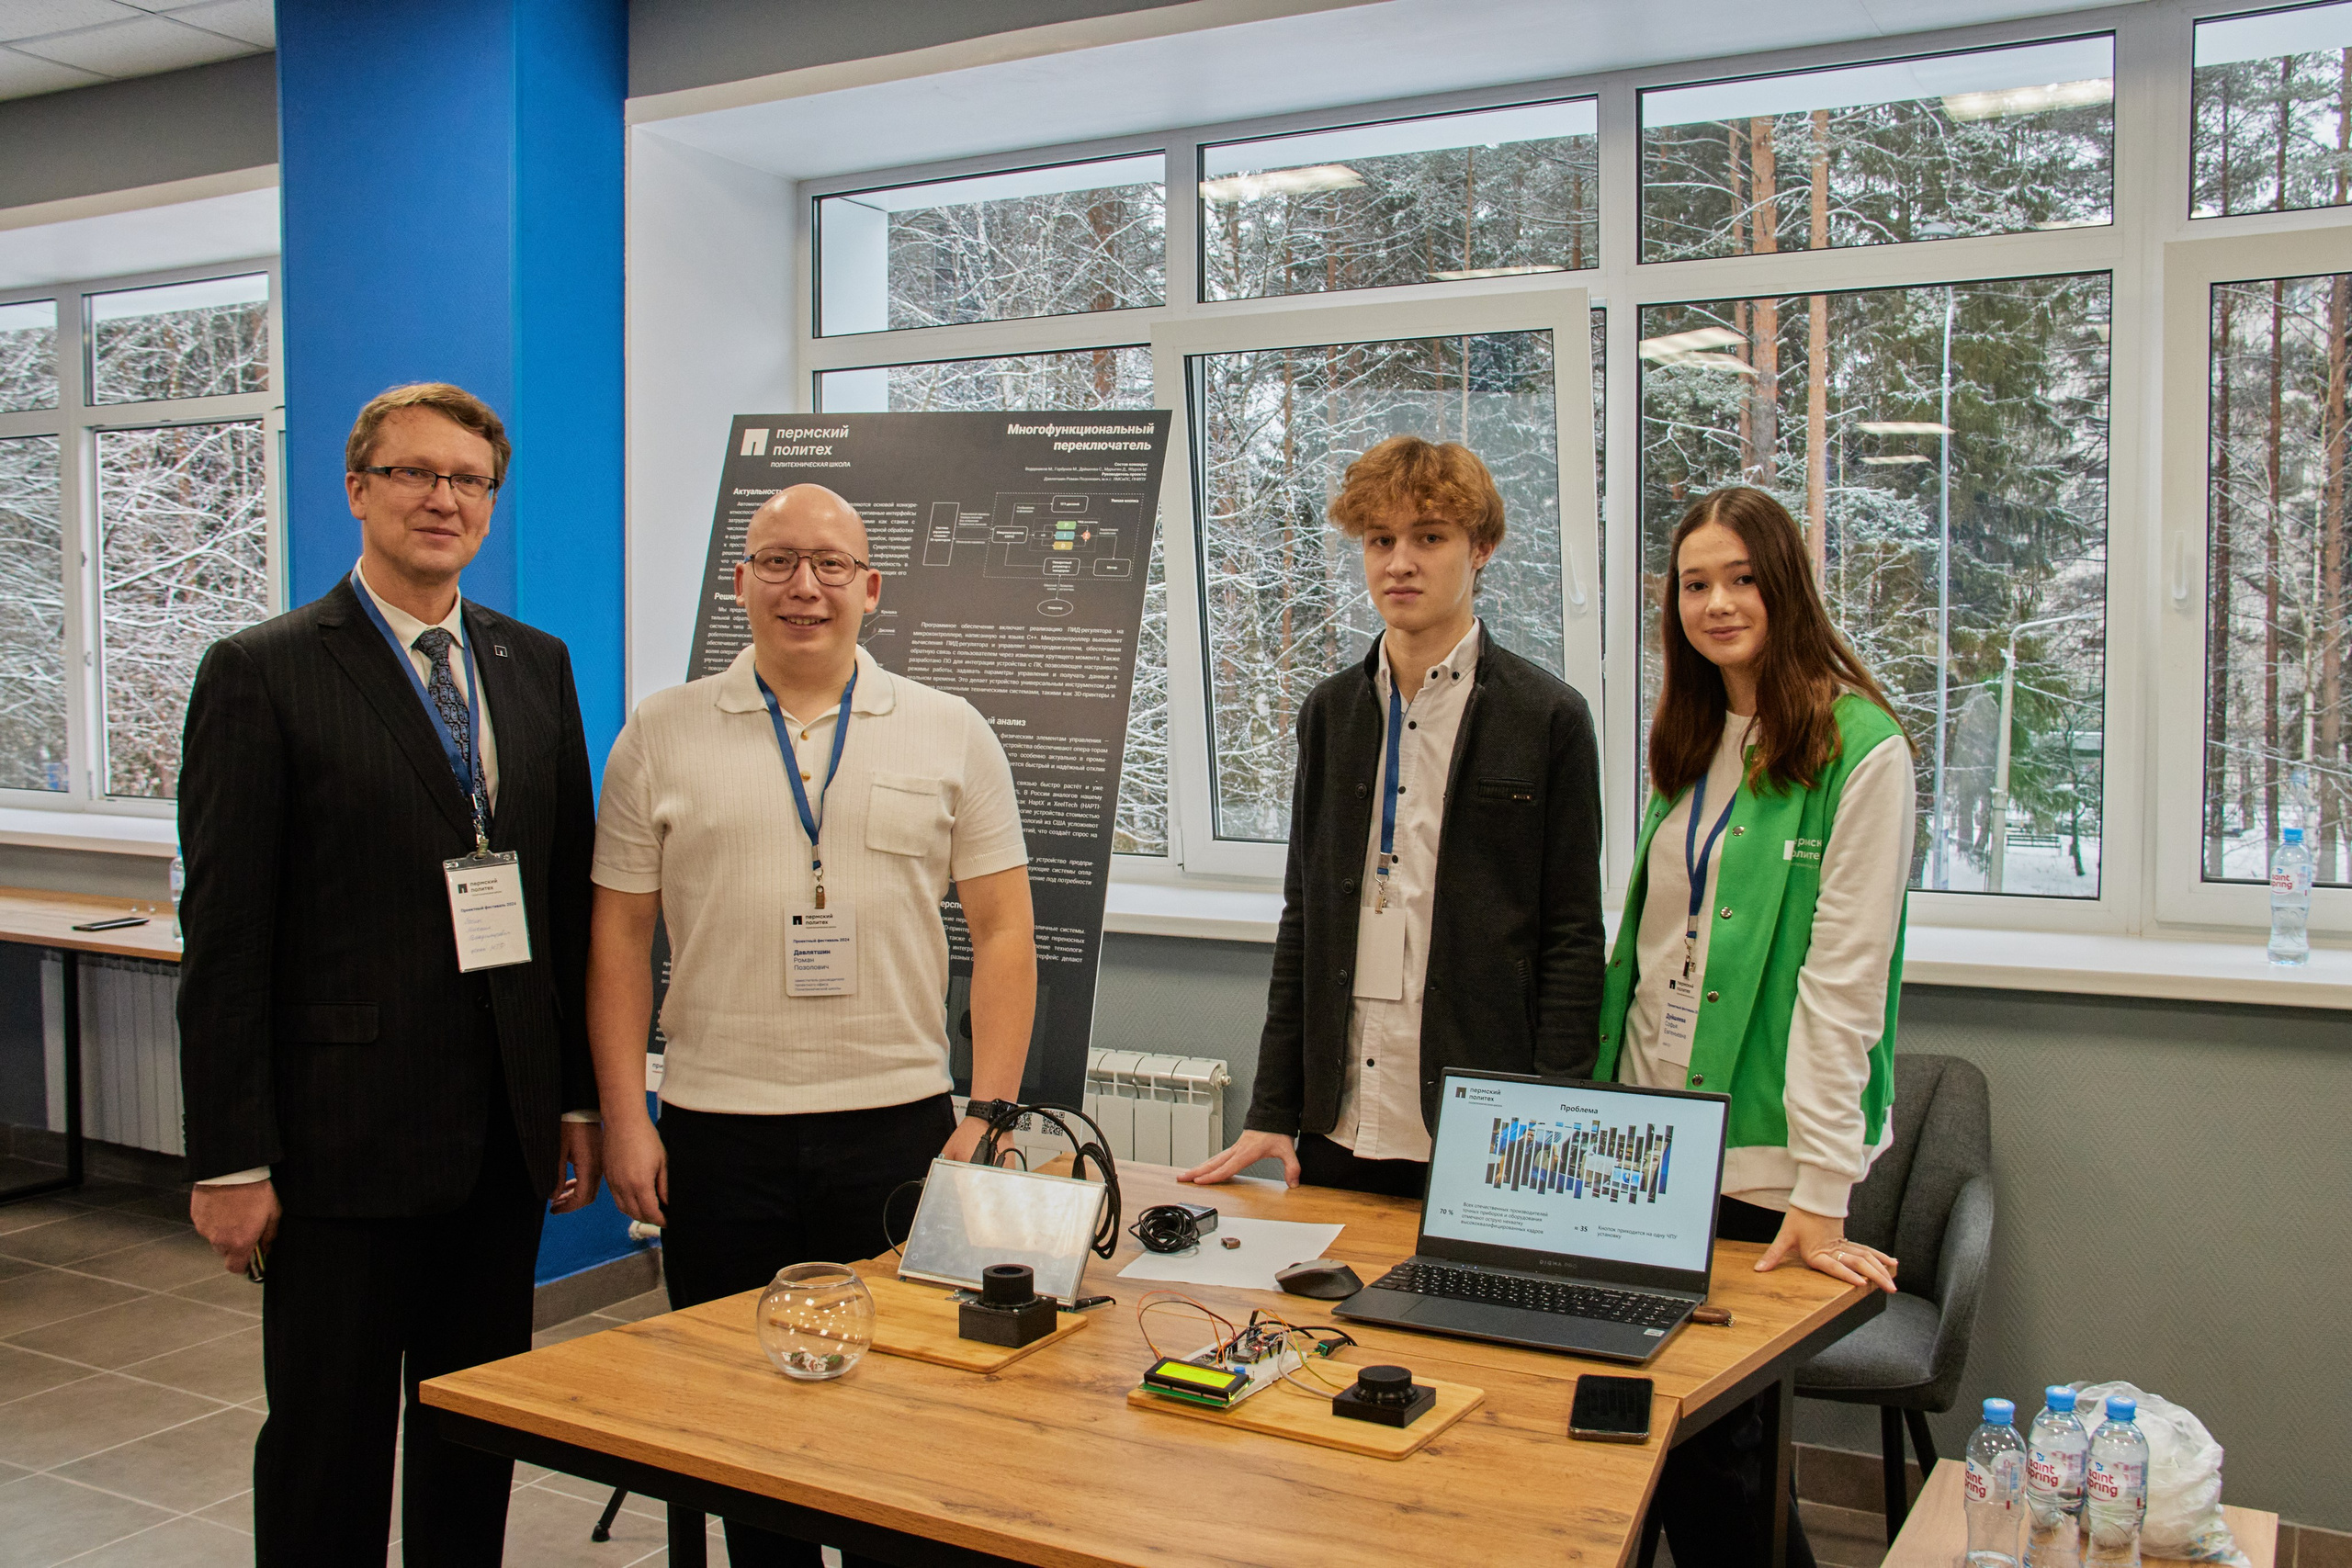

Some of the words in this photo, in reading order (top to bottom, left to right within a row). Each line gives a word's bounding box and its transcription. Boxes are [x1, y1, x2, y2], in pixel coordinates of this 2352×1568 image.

[776, 425, 850, 442] пермский
[1007, 423, 1155, 437] Многофункциональный
[773, 445, 832, 456] политех
[1053, 441, 1152, 453] переключатель
[922, 621, 957, 629] Программное
[997, 718, 1026, 727] анализ
[1025, 761, 1049, 770] быстрый
[1035, 856, 1067, 864] устройство
[2270, 880, 2293, 890] pring
[1051, 935, 1085, 943] переносных
[1061, 955, 1082, 964] делают
[1470, 1087, 1501, 1096] пермский
[1469, 1094, 1495, 1102] политех
[1560, 1103, 1599, 1114] Проблема
[1510, 1208, 1548, 1217] производителей
[1509, 1213, 1543, 1222] оборудования
[1617, 1227, 1645, 1235] приходится
[2030, 1459, 2055, 1475] saint
[1965, 1471, 1983, 1485] aint
[2088, 1468, 2114, 1484] saint
